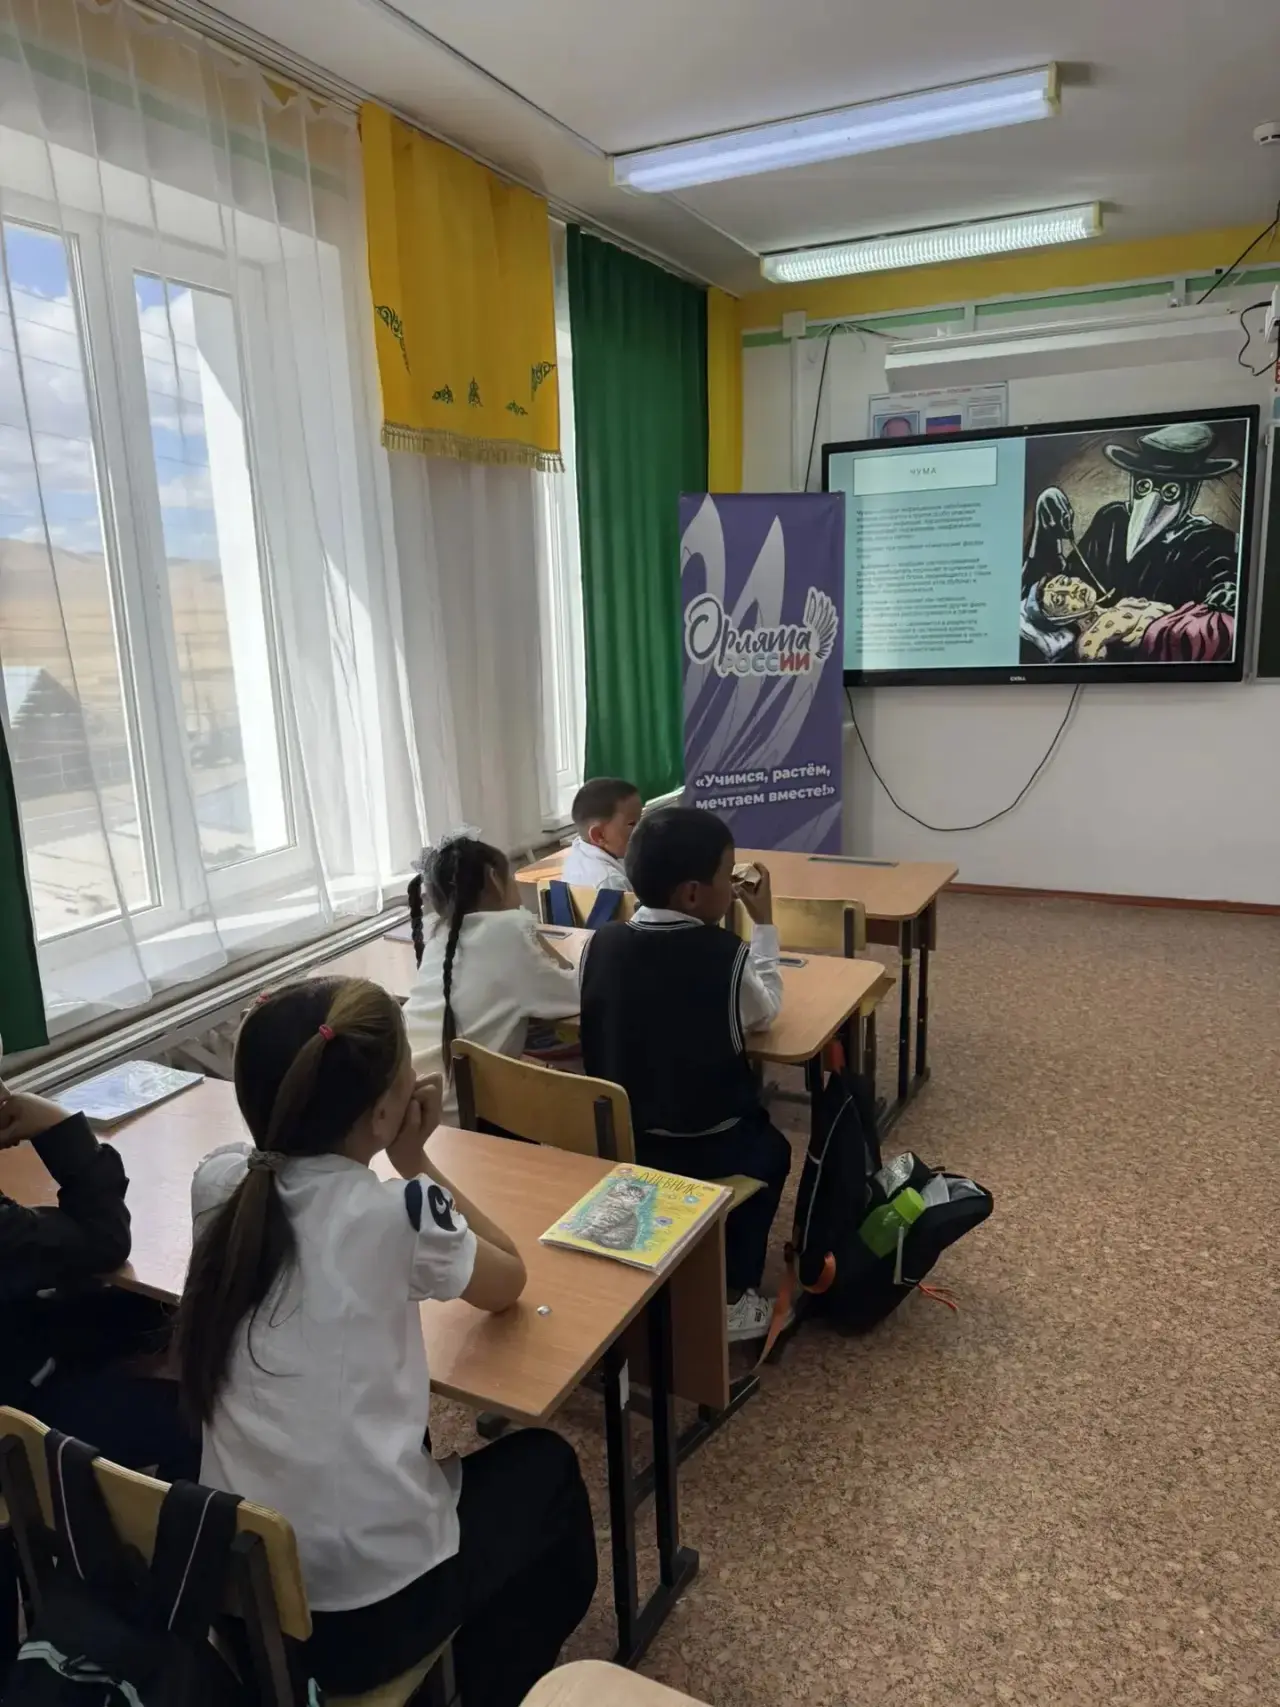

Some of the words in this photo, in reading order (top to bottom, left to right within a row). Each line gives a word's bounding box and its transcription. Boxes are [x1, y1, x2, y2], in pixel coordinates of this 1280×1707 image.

[909, 467, 937, 475] ЧУМА
[689, 597, 812, 666] Орлята
[722, 651, 810, 673] РОССИИ
[695, 771, 769, 788] «Учимся,
[772, 762, 832, 783] растём,
[695, 793, 765, 810] мечтаем
[768, 784, 836, 803] вместе!»
